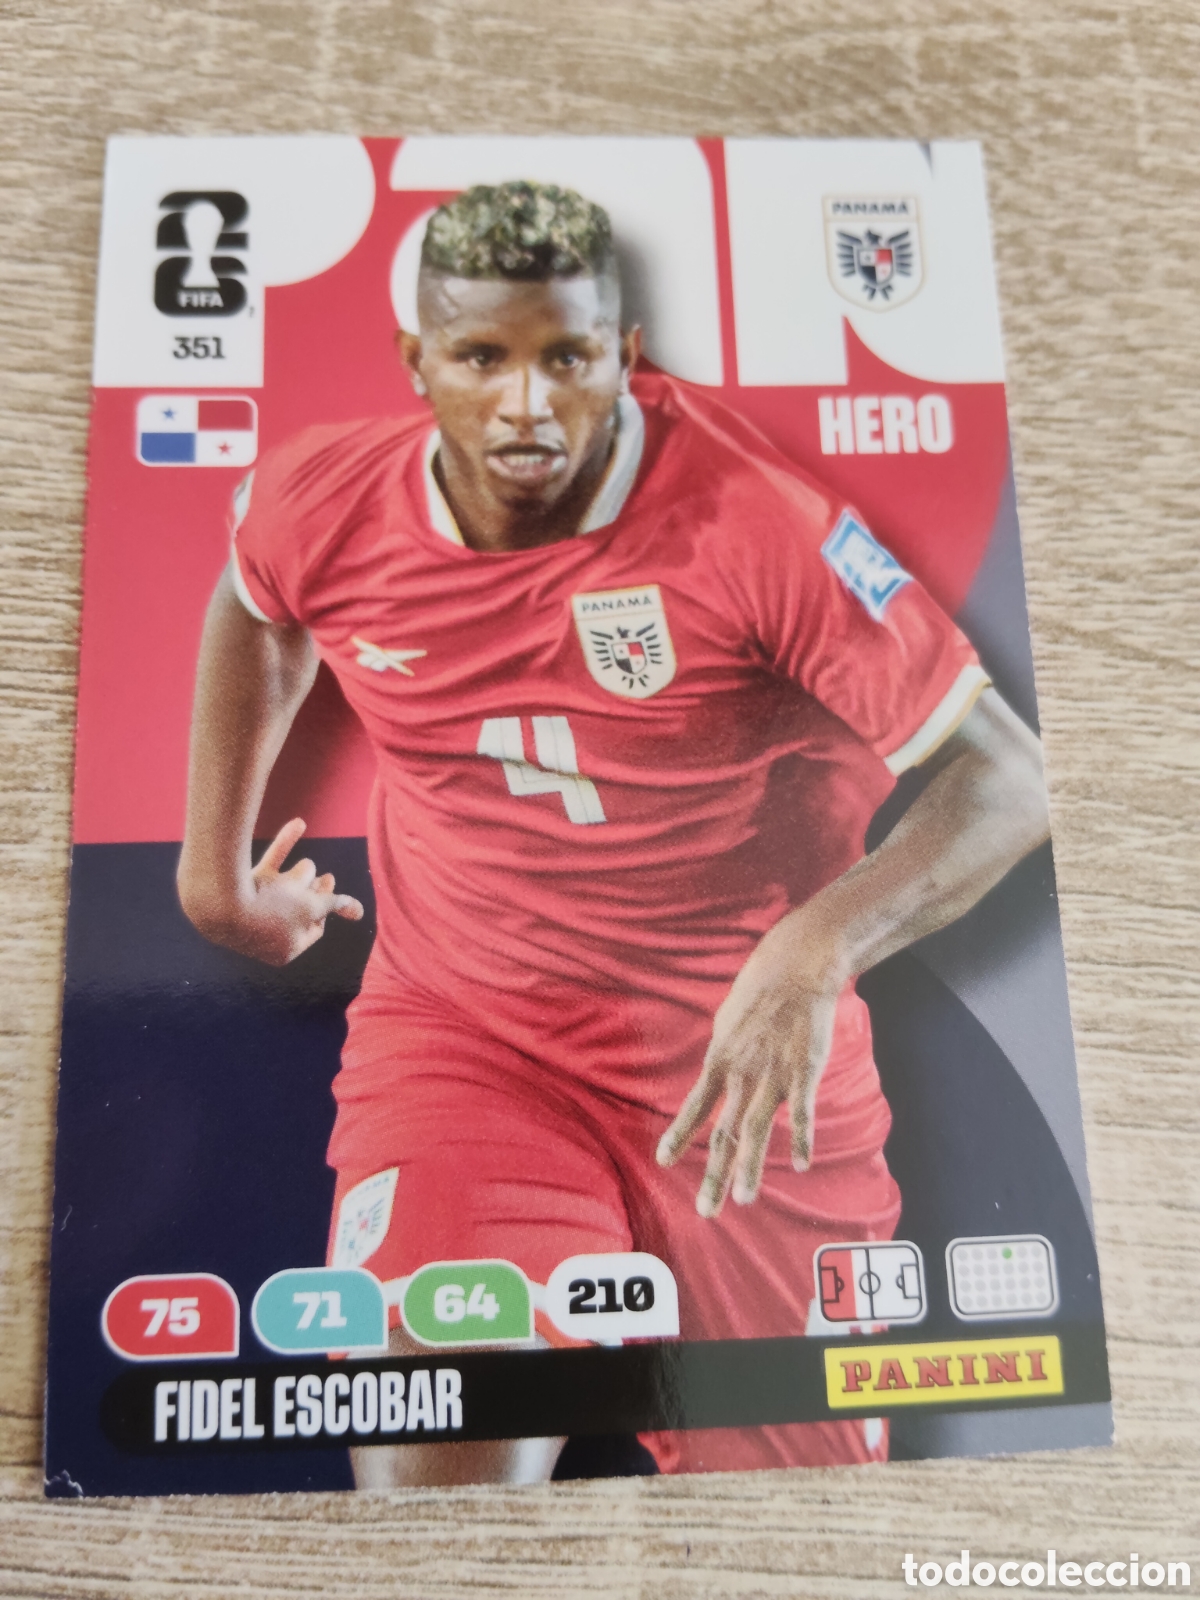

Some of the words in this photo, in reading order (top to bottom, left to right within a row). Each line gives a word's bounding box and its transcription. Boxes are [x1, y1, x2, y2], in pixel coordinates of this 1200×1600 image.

[177, 291, 225, 308] FIFA
[172, 336, 225, 360] 351
[818, 395, 954, 455] HERO
[476, 716, 607, 825] 4
[292, 1290, 348, 1330] 71
[433, 1284, 500, 1323] 64
[568, 1277, 655, 1314] 210
[140, 1297, 201, 1338] 75
[840, 1350, 1049, 1392] PANINI
[153, 1377, 265, 1442] FIDEL
[272, 1368, 464, 1439] ESCOBAR
